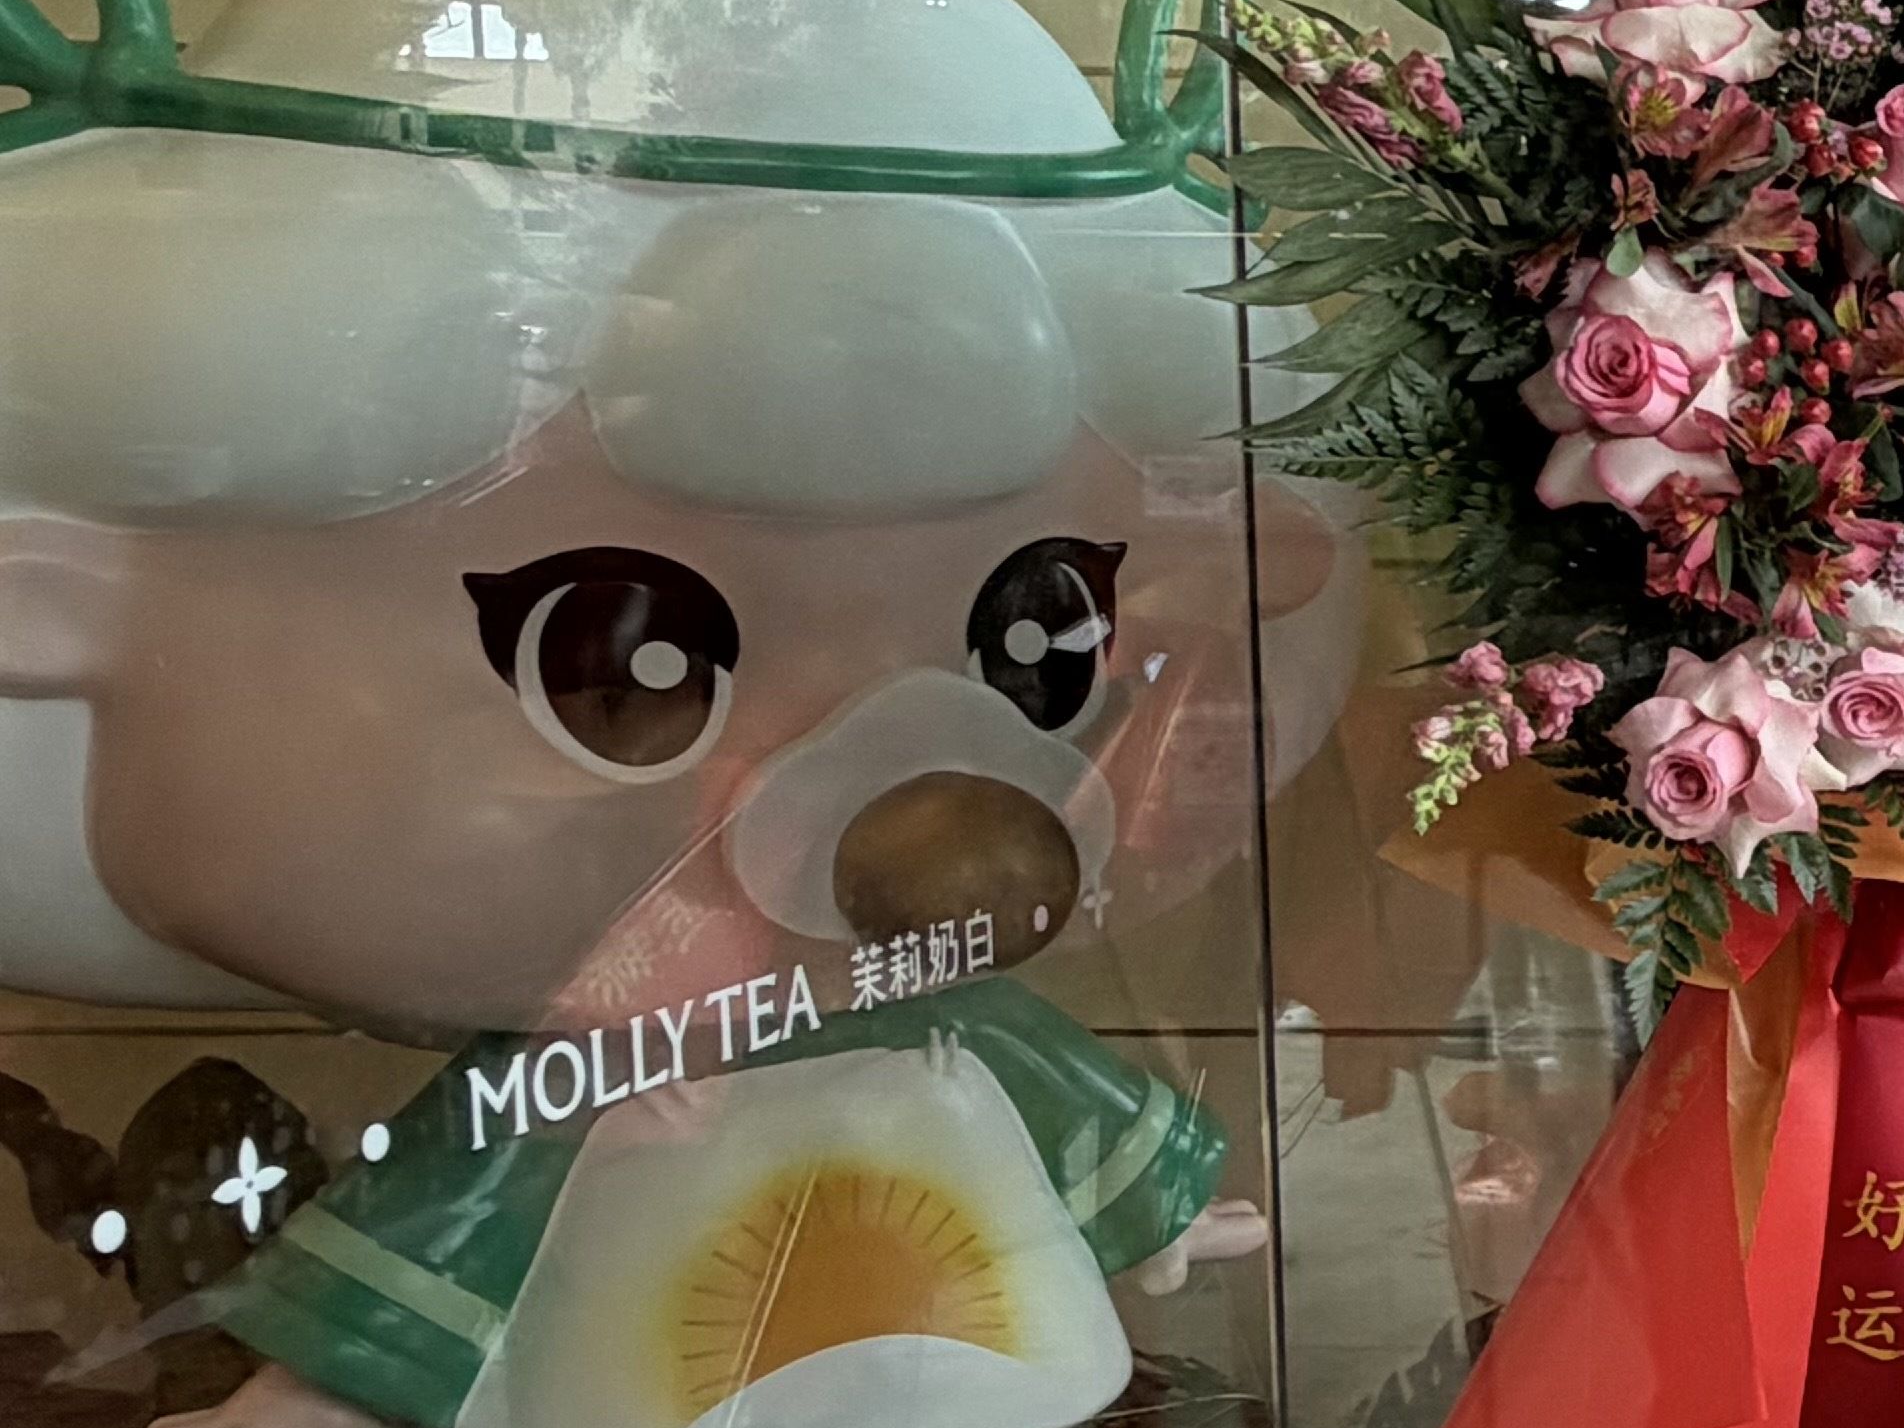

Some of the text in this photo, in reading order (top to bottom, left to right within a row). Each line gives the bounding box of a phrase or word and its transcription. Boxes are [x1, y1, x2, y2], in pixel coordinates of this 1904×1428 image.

[849, 908, 996, 1013] 茉莉奶白
[465, 964, 822, 1151] MOLLY TEA
